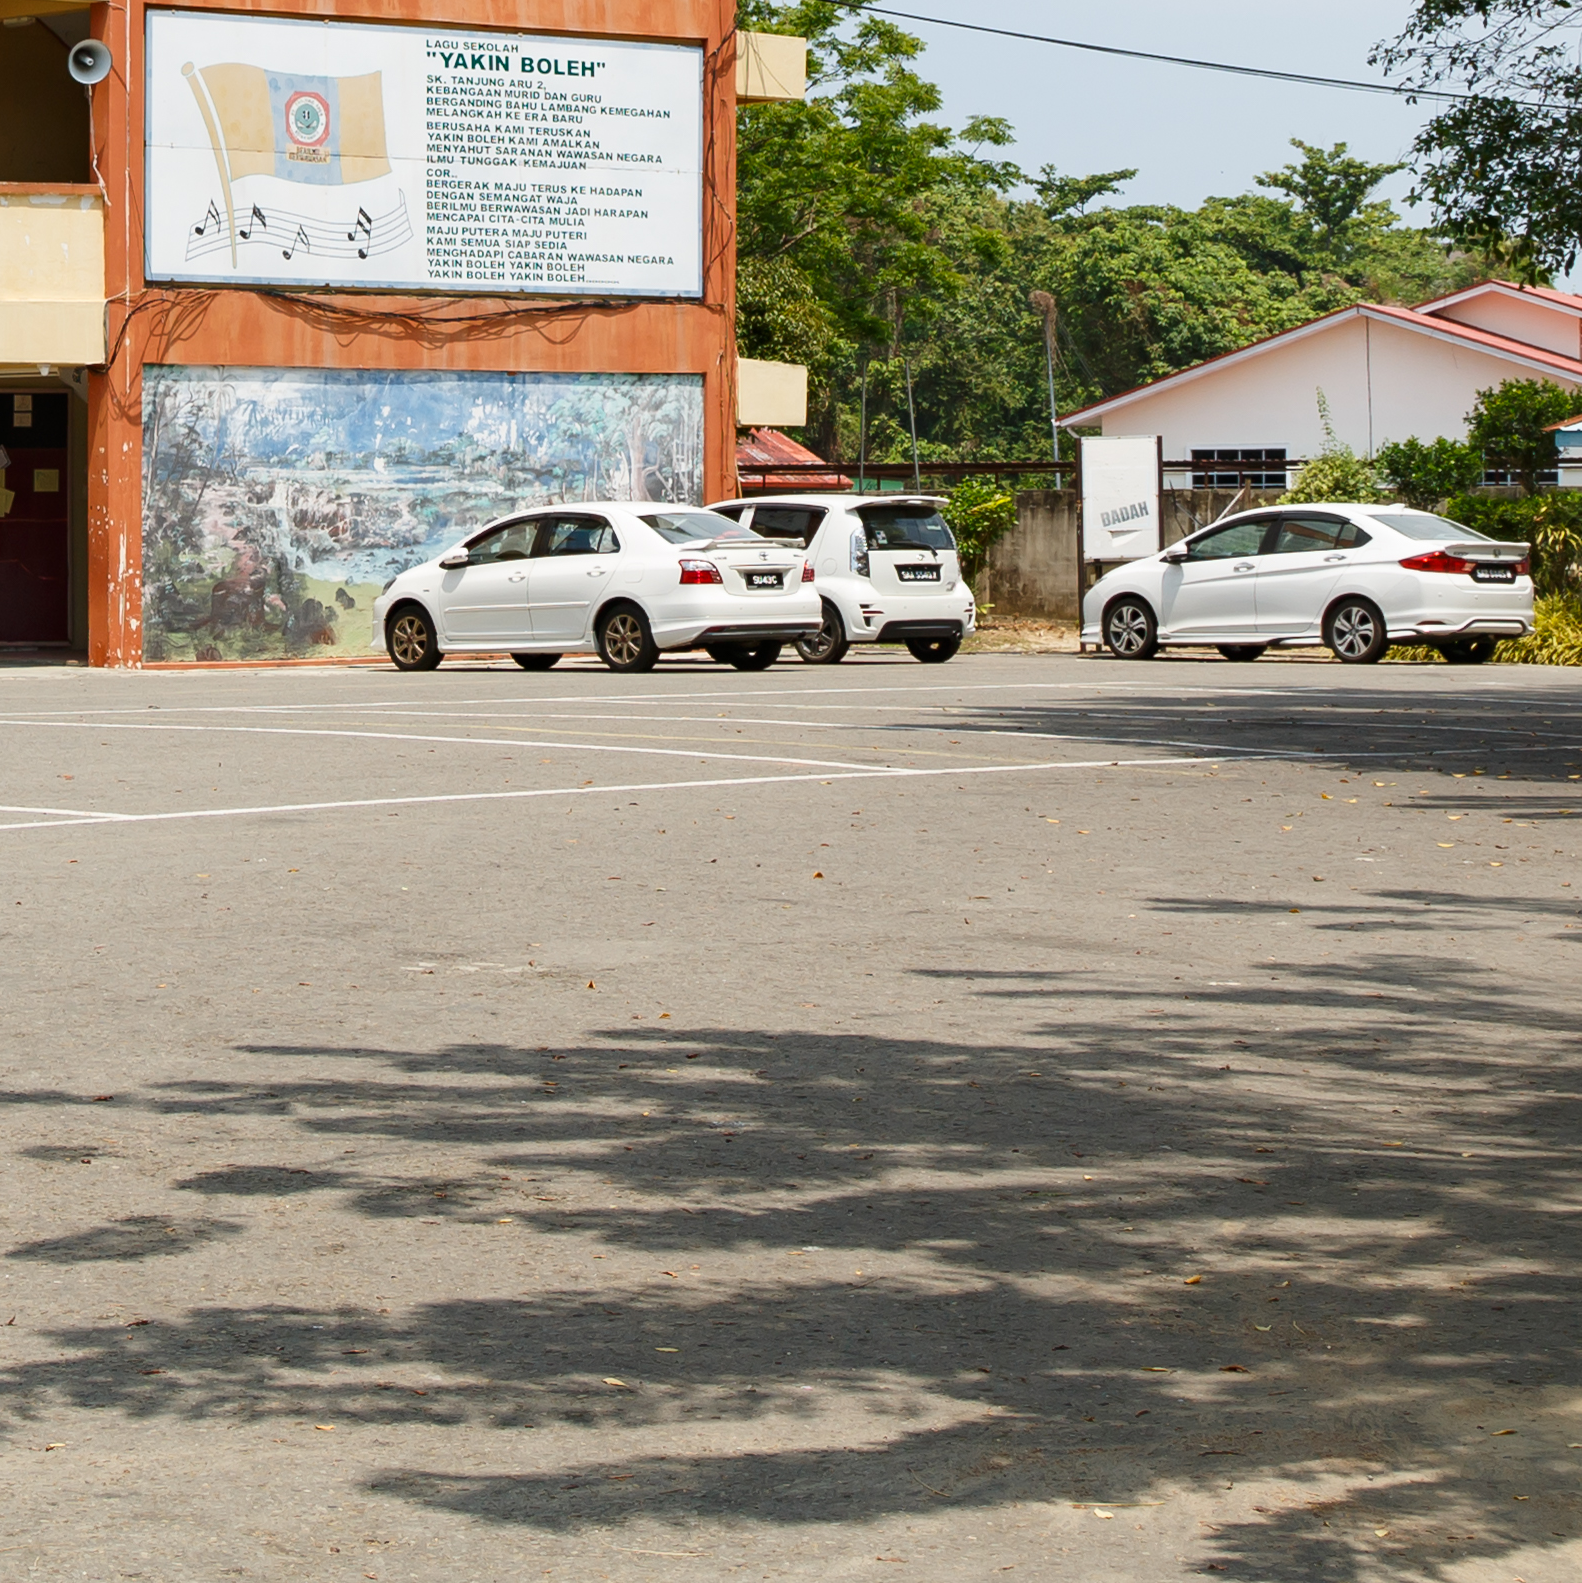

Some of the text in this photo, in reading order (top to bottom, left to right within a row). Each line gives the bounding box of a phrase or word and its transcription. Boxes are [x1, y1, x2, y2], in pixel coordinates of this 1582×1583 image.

[426, 39, 518, 53] LAGU SEKOLAH
[426, 51, 605, 77] "YAKIN BOLEH"
[427, 75, 446, 84] SK.
[451, 76, 504, 87] TANJUNG
[509, 79, 532, 89] ARU
[427, 86, 601, 103] KEBANGAAN MURID DAN GURU
[427, 97, 670, 118] BERGANDING BAHU LAMBANG KEMEGAHAN
[426, 108, 582, 124] MELANGKAH KE ERA BARU
[427, 121, 590, 138] BERUSAHA KAMI TERUSKAN
[428, 133, 599, 149] YAKIN BOLEH KAMI AMALKAN
[427, 144, 662, 163] MENYAHUT SARANAN WAWASAN NEGARA
[426, 155, 586, 169] ILMU TUNGGAK KEMAJUAN
[426, 179, 642, 197] BERGERAK MAJU TERUS KE HADAPAN
[427, 190, 577, 205] DENGAN SEMANGAT WAJA
[427, 201, 648, 218] BERILMU BERWAWASAN JADI HARAPAN
[427, 212, 585, 226] MENCAPAI CITA-CITA MULIA
[427, 226, 586, 240] MAJU PUTERA MAJU PUTERI
[427, 237, 567, 250] KAMI SEMUA SIAP SEDIA
[427, 248, 673, 264] MENGHADAPI CABARAN WAWASAN NEGARA
[428, 259, 584, 272] YAKIN BOLEH YAKIN BOLEH
[428, 270, 462, 278] YAKIN
[467, 271, 505, 280] BOLEH
[510, 272, 543, 281] YAKIN
[1100, 500, 1149, 528] BADAH
